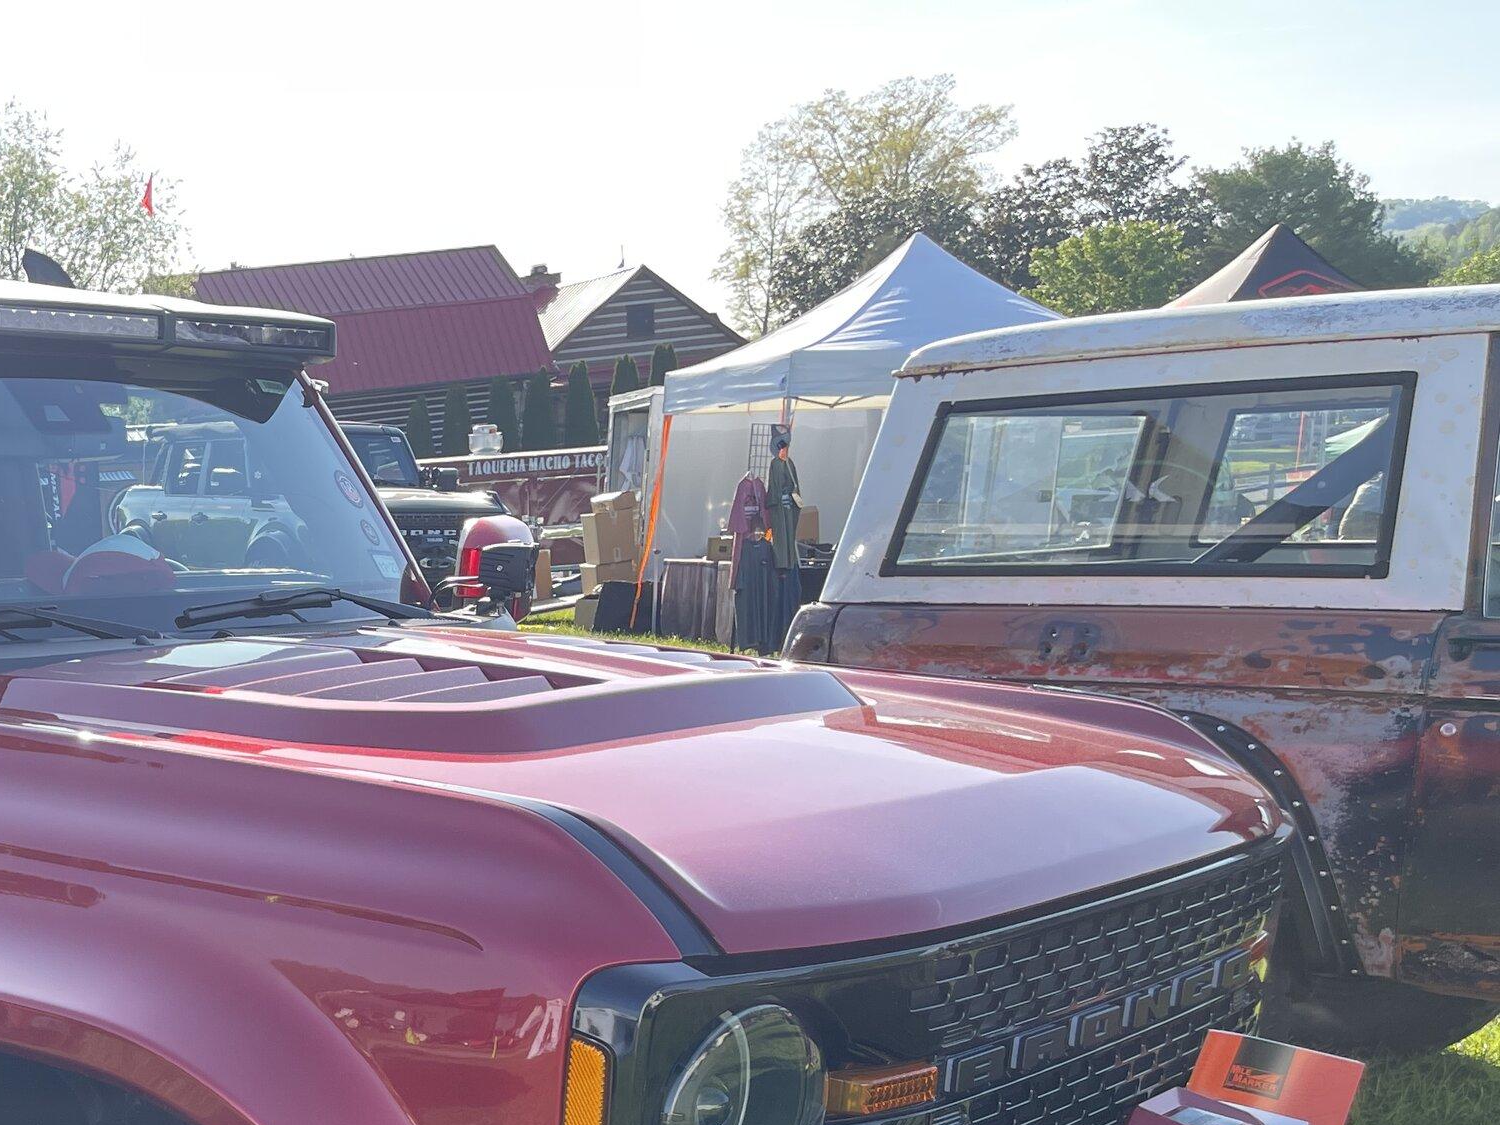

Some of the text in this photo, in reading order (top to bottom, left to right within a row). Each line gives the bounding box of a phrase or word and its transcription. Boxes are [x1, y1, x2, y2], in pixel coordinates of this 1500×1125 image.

[467, 460, 527, 477] TAQUERIA
[528, 455, 571, 471] MACHO
[944, 949, 1252, 1093] BRONCO
[1233, 1072, 1278, 1094] MARKER
